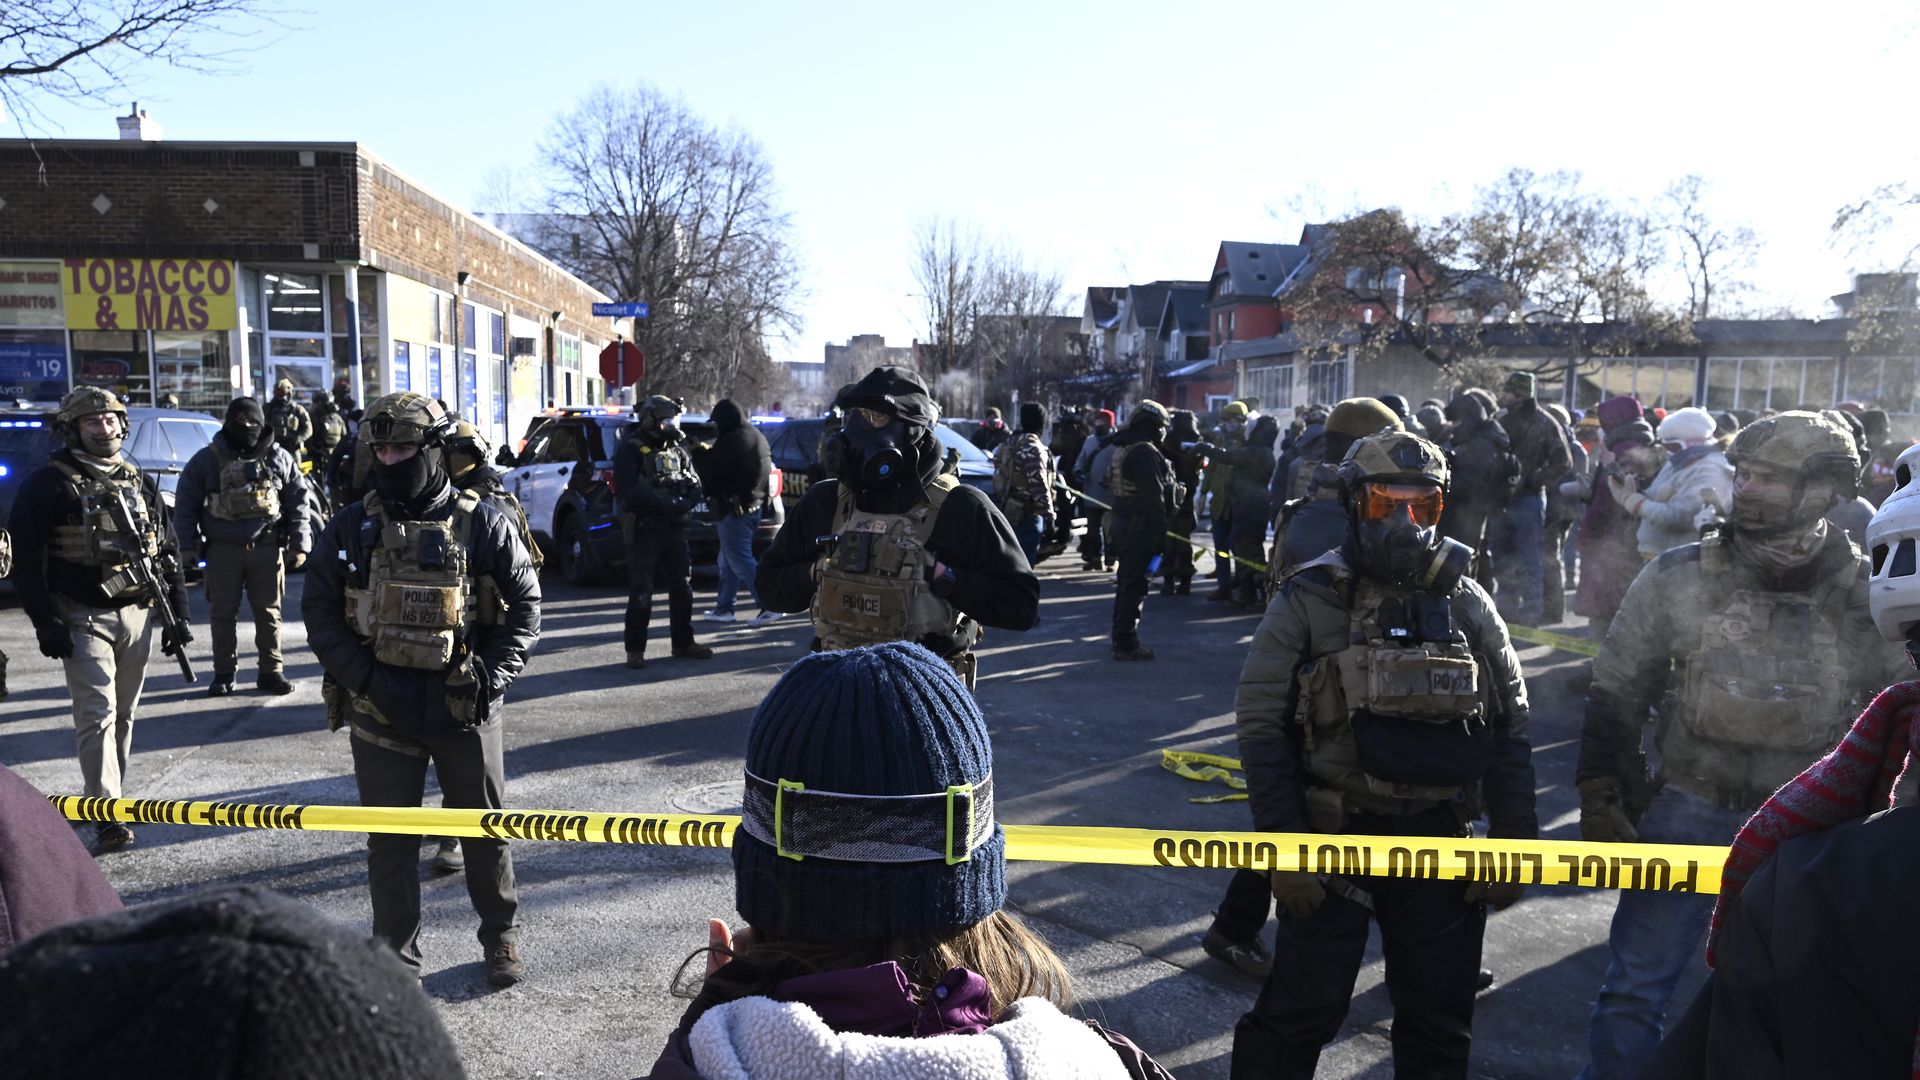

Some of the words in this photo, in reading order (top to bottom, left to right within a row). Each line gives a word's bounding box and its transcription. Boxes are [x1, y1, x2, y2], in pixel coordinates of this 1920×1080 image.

[64, 258, 231, 295] TOBACCO
[95, 295, 118, 330] &
[135, 295, 209, 330] MAS
[593, 306, 627, 315] Nicollet
[634, 306, 647, 315] Av
[404, 590, 440, 604] POLICE
[842, 594, 879, 613] POLICE
[480, 812, 590, 843] CROSS
[603, 816, 669, 846] NOT
[679, 819, 726, 848] DO
[1153, 838, 1278, 871] CROSS
[1297, 843, 1372, 876] NOT
[1388, 846, 1439, 879] DO
[1453, 849, 1543, 885] LINE
[1558, 855, 1698, 894] POLICE
